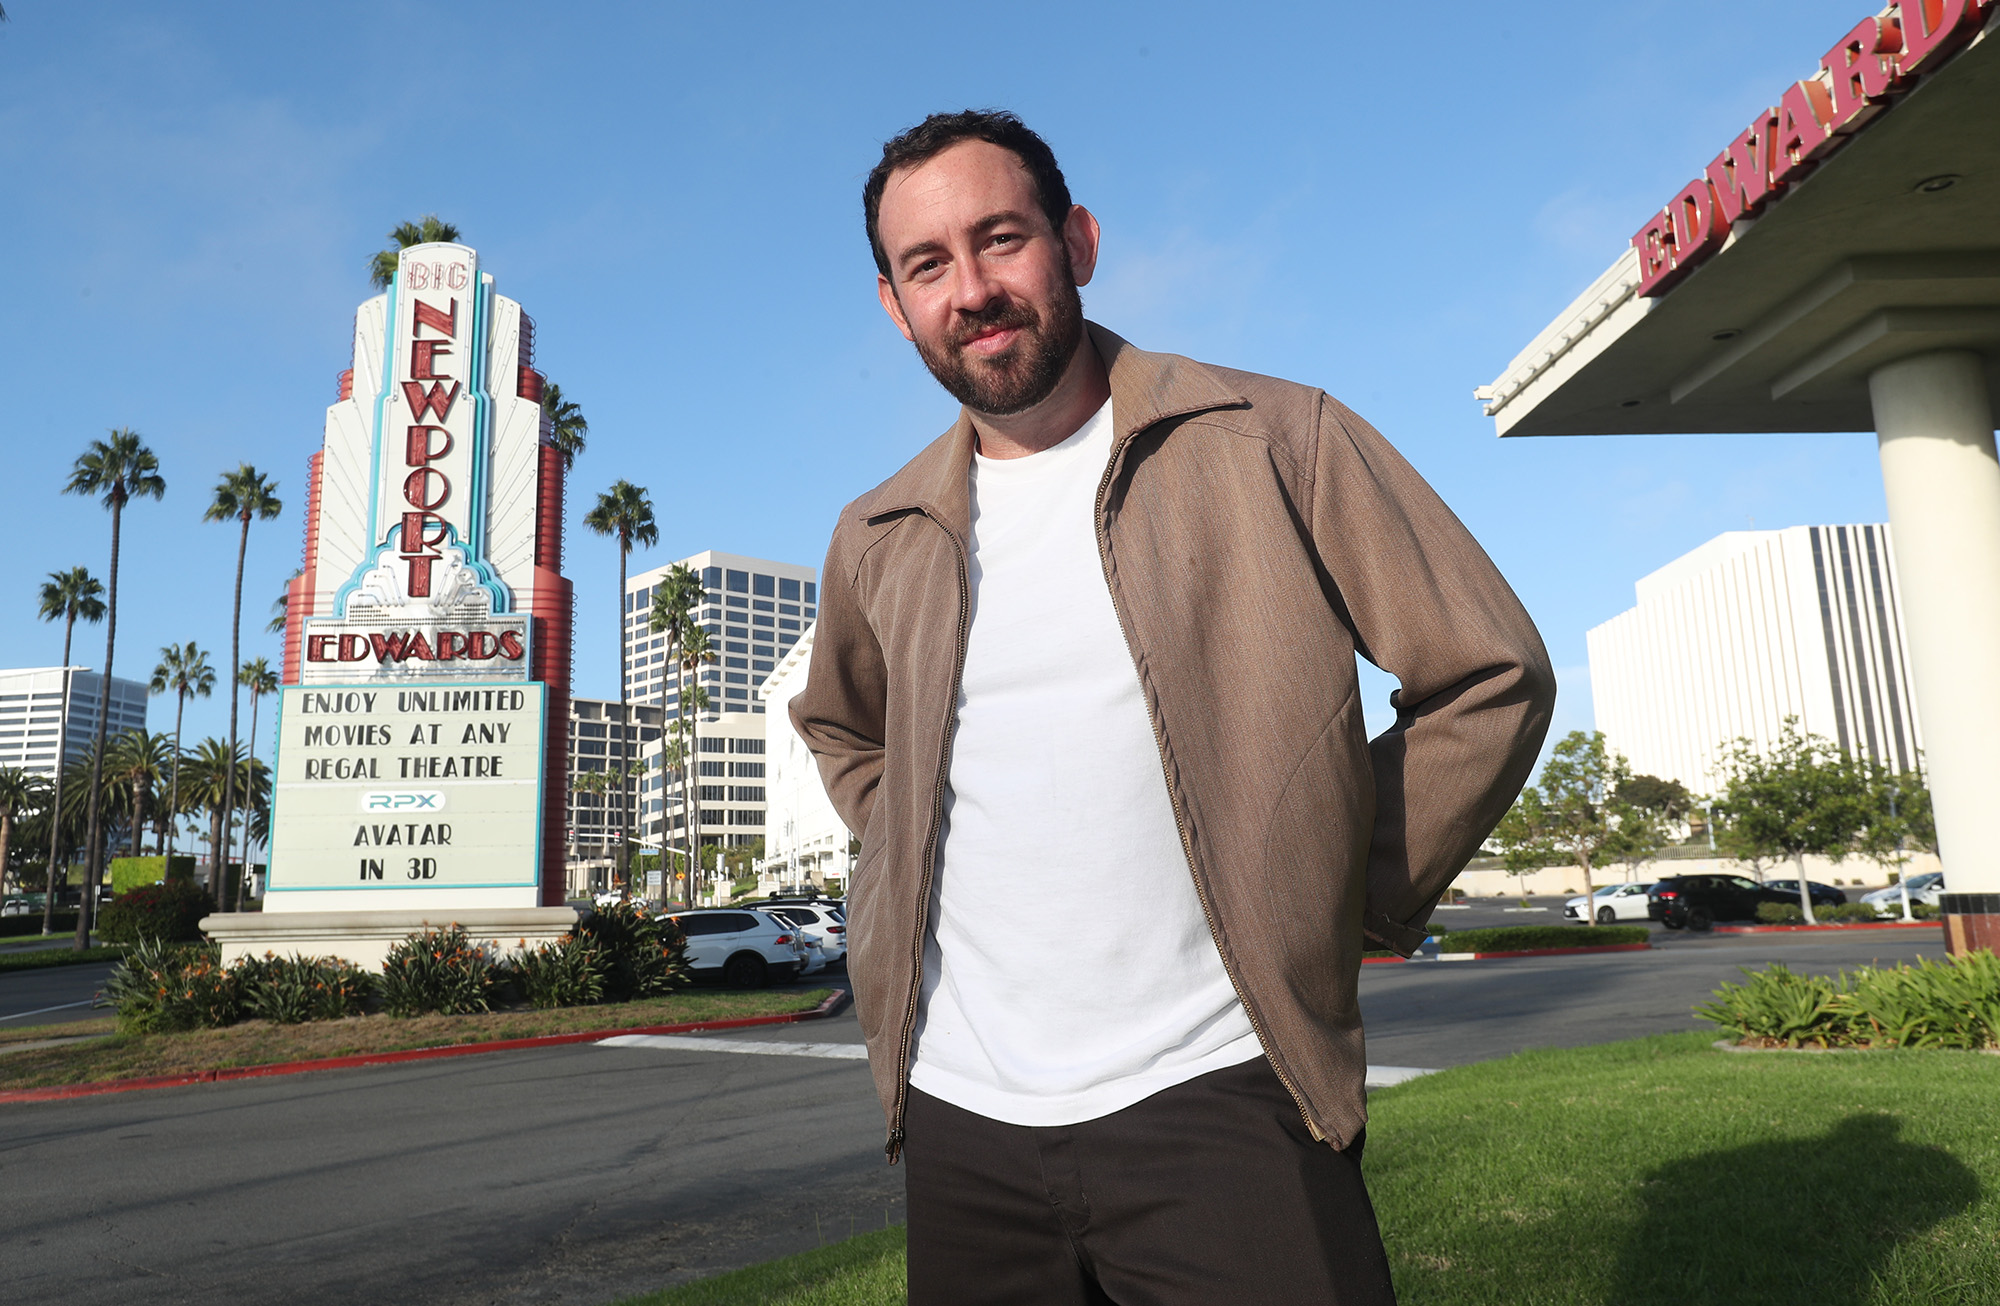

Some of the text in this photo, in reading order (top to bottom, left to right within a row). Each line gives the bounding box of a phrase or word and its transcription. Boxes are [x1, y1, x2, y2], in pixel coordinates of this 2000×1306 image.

[1629, 0, 1994, 297] EDWARD
[407, 262, 468, 291] BIG
[400, 297, 459, 598] NEWPORT
[307, 630, 524, 664] EDWARDS
[302, 689, 525, 714] ENJOY UNLIMITED
[304, 722, 511, 746] MOVIES AT ANY
[305, 755, 503, 780] REGAL THEATRE
[369, 794, 437, 809] RPX
[353, 823, 452, 847] AVATAR
[360, 857, 437, 881] IN 3D
